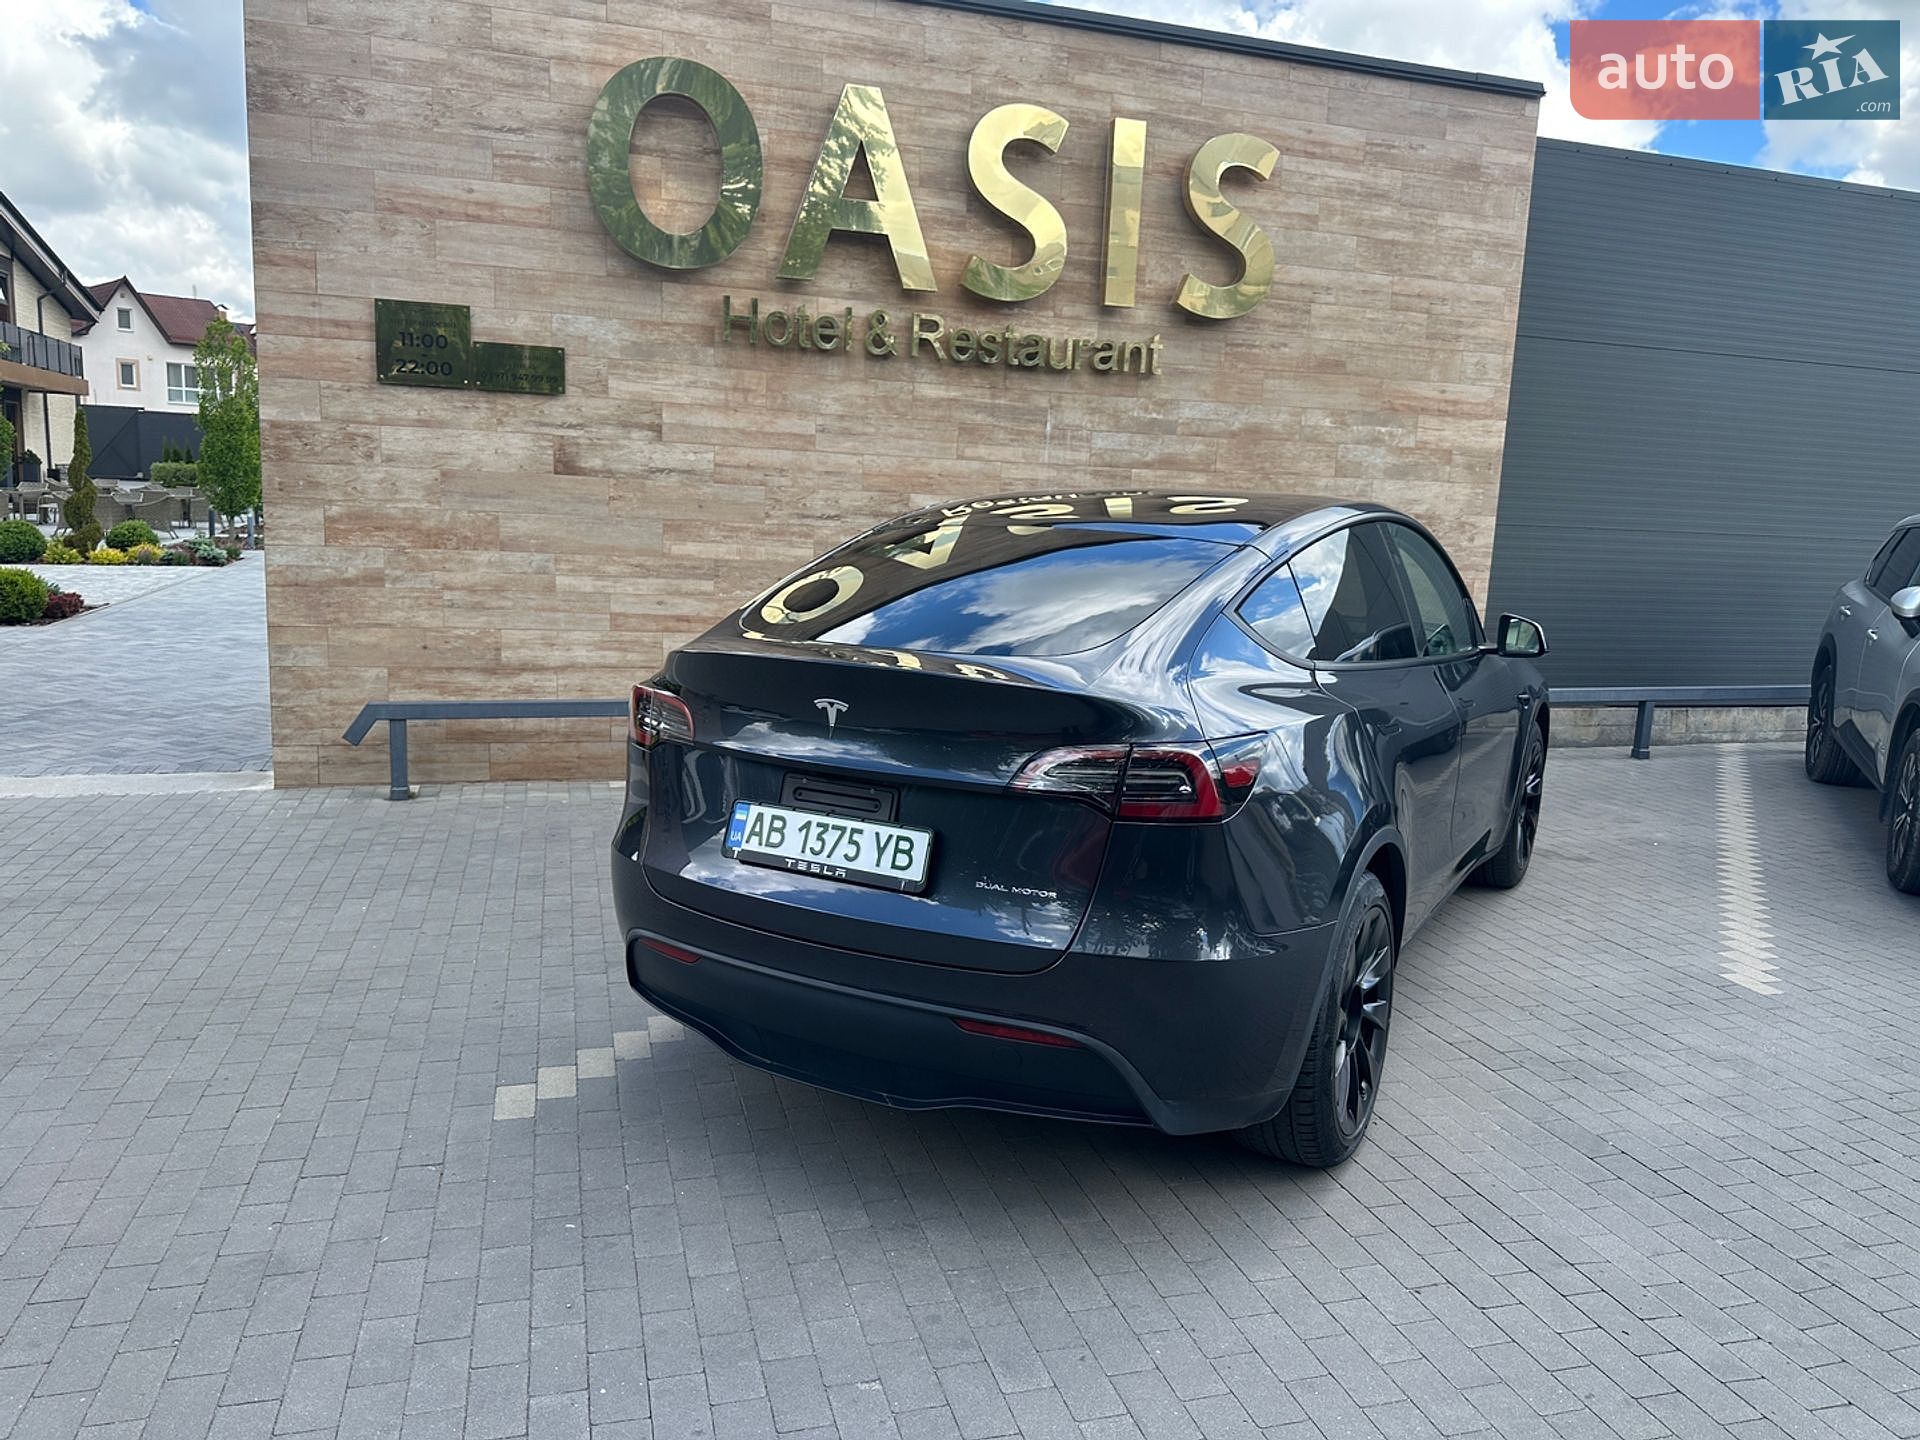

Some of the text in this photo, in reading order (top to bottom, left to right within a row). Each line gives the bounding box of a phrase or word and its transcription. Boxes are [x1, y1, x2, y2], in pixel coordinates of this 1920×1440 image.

[586, 56, 1281, 320] OASIS
[399, 331, 449, 350] 11:00
[721, 294, 1165, 377] Hotel & Restaurant
[395, 359, 453, 377] 22:00
[730, 830, 742, 842] UA
[746, 811, 915, 871] AB 1375 YB
[785, 858, 847, 878] TESLA
[976, 881, 1057, 899] DUAL MOTOR
